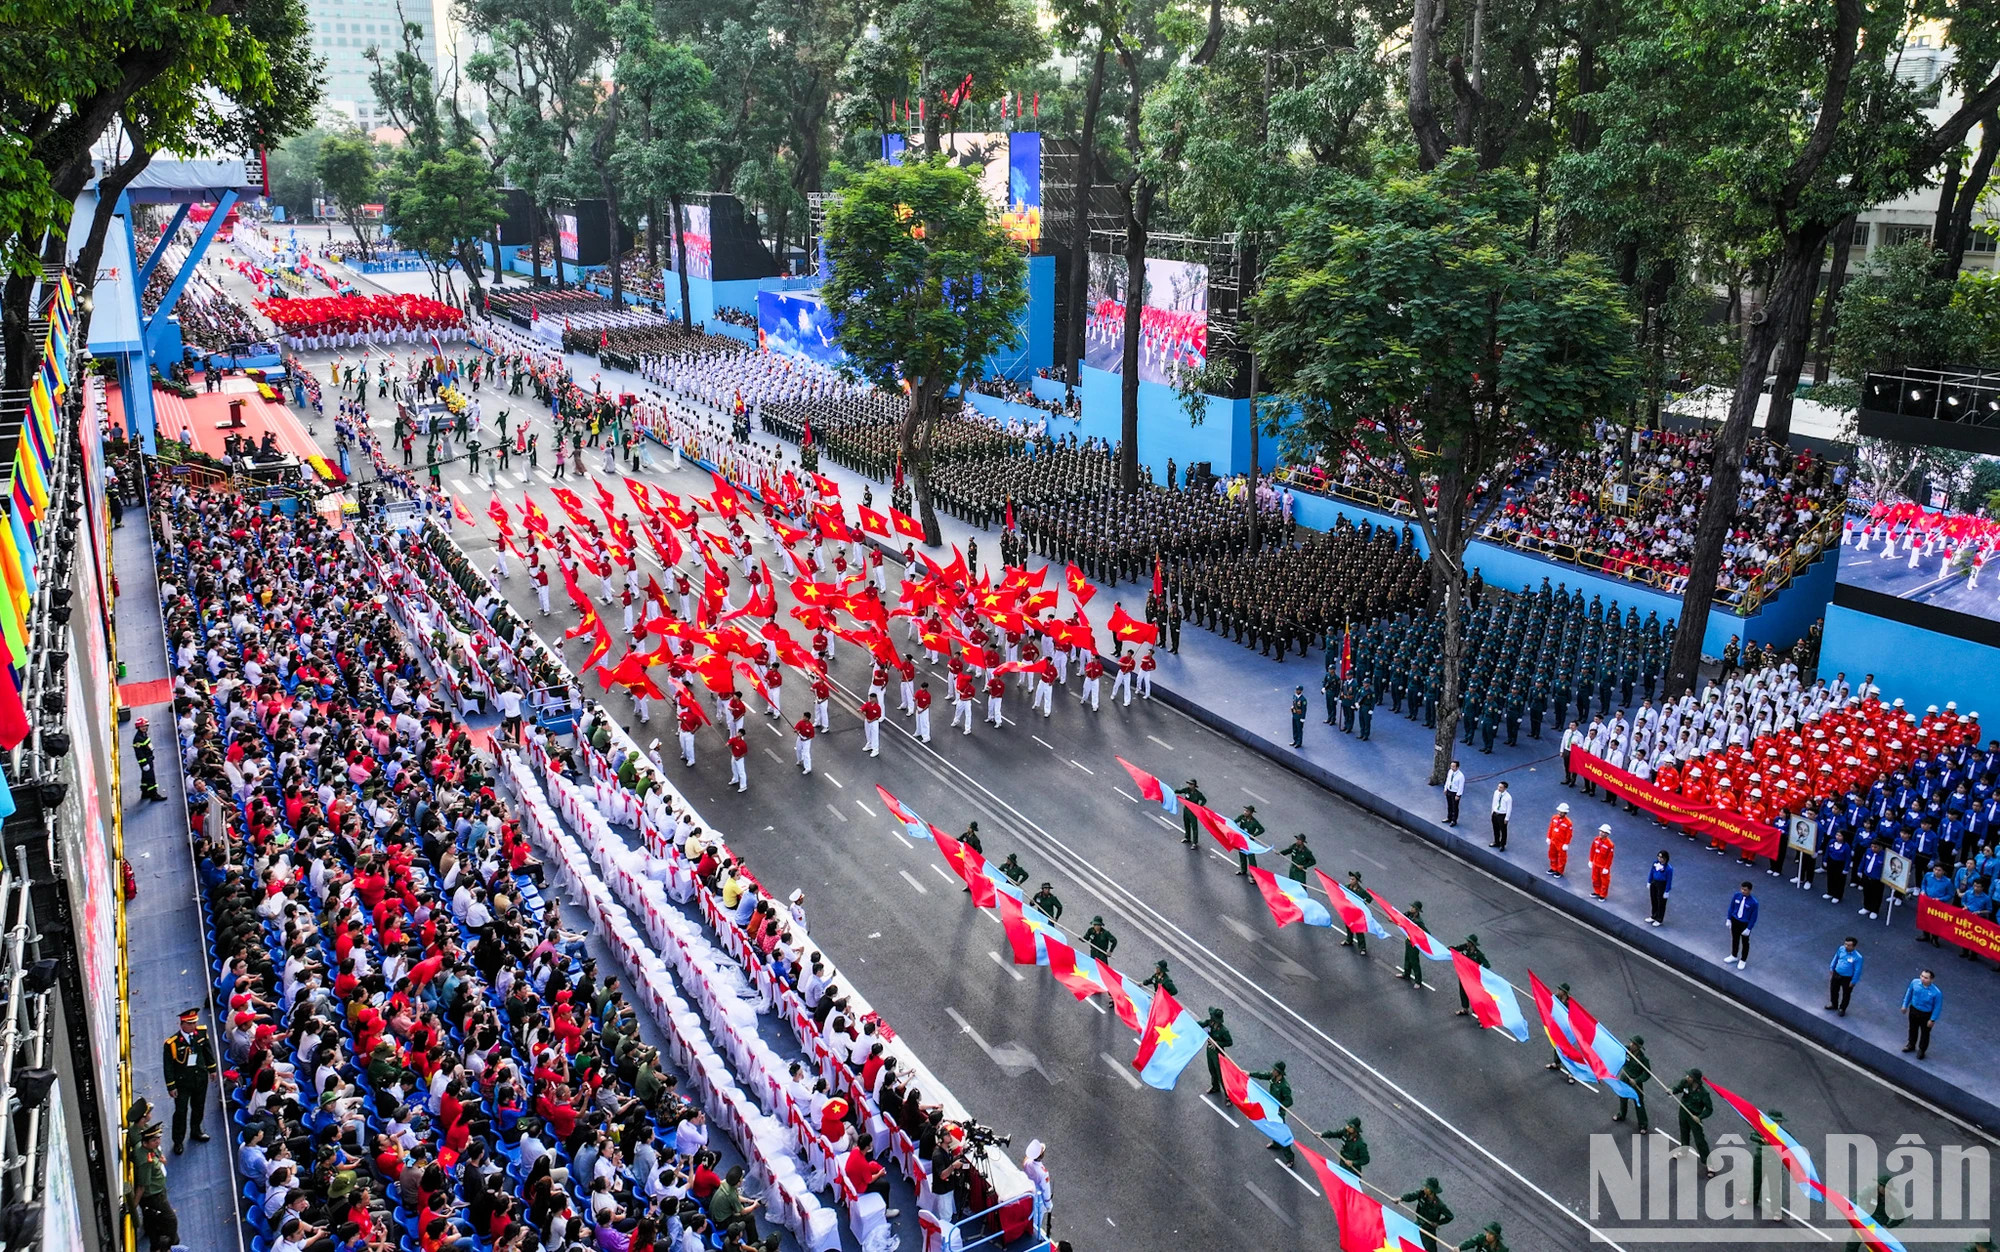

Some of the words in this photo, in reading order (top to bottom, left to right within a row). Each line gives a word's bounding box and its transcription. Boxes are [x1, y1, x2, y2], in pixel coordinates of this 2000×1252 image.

[1603, 773, 1624, 787] CỘNG
[1624, 783, 1638, 795] SẢN
[1639, 790, 1653, 802] VIỆT
[1653, 797, 1670, 809] NAM
[1717, 819, 1740, 834] MUÔN
[1927, 907, 1953, 922] NHIỆT
[1955, 917, 1973, 929] LIỆT
[1954, 927, 1987, 947] THỐNG
